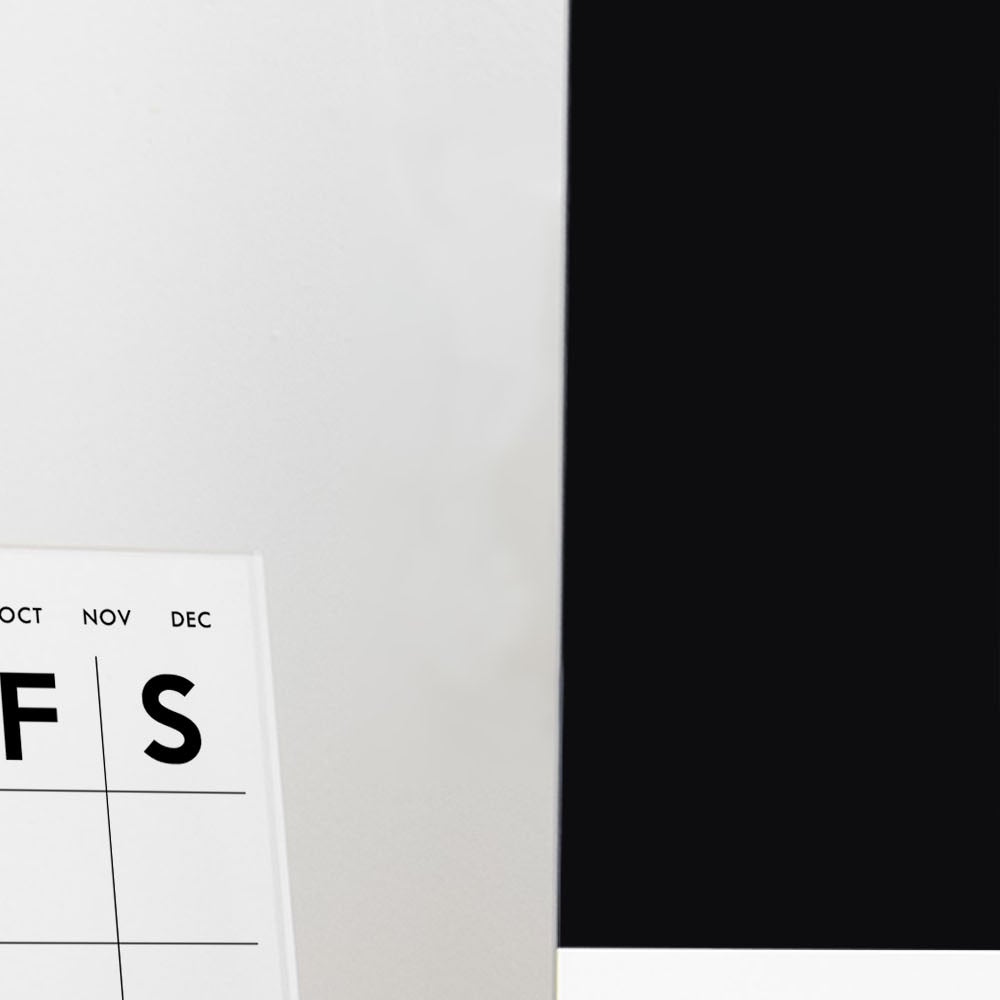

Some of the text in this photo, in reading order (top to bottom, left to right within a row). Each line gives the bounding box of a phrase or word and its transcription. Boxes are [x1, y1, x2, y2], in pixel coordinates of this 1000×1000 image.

[82, 608, 131, 627] NOV
[170, 610, 212, 628] DEC
[0, 671, 59, 761] F
[141, 673, 202, 765] S
